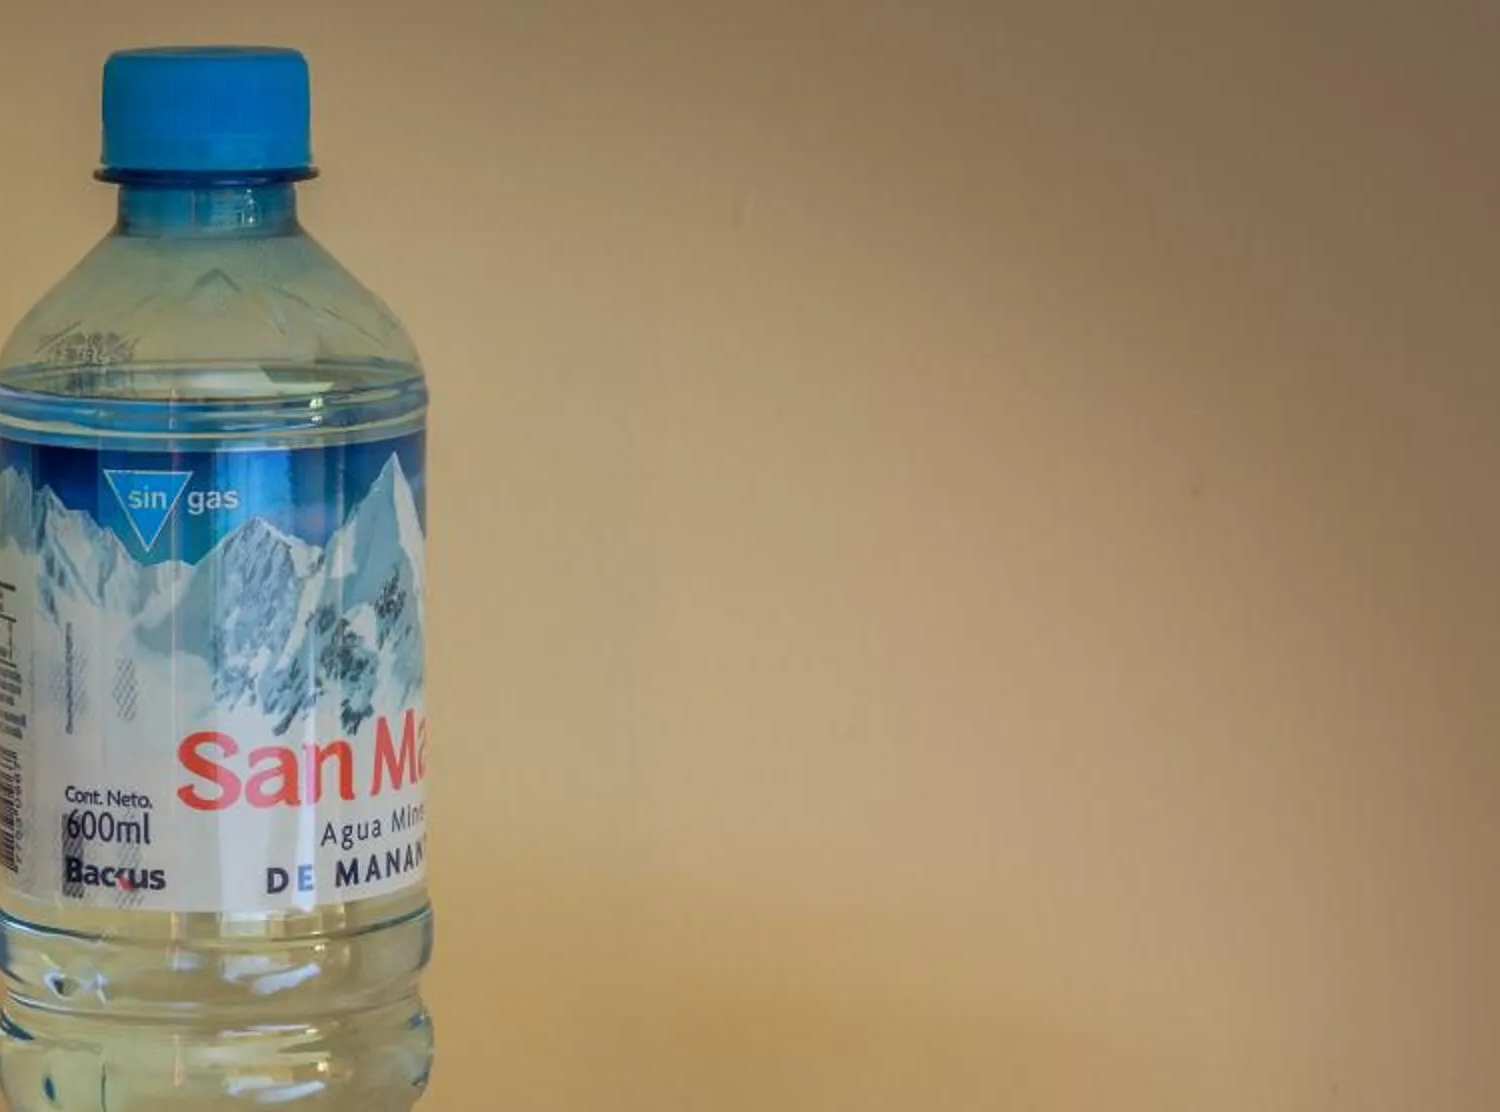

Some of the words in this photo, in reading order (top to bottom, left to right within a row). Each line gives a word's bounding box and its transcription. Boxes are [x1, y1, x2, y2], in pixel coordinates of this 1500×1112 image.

[128, 485, 168, 509] sin
[187, 486, 240, 515] gas
[177, 731, 355, 812] San
[64, 784, 104, 807] Cont.
[66, 808, 151, 845] 600ml
[320, 820, 382, 851] Agua
[266, 864, 315, 895] DE
